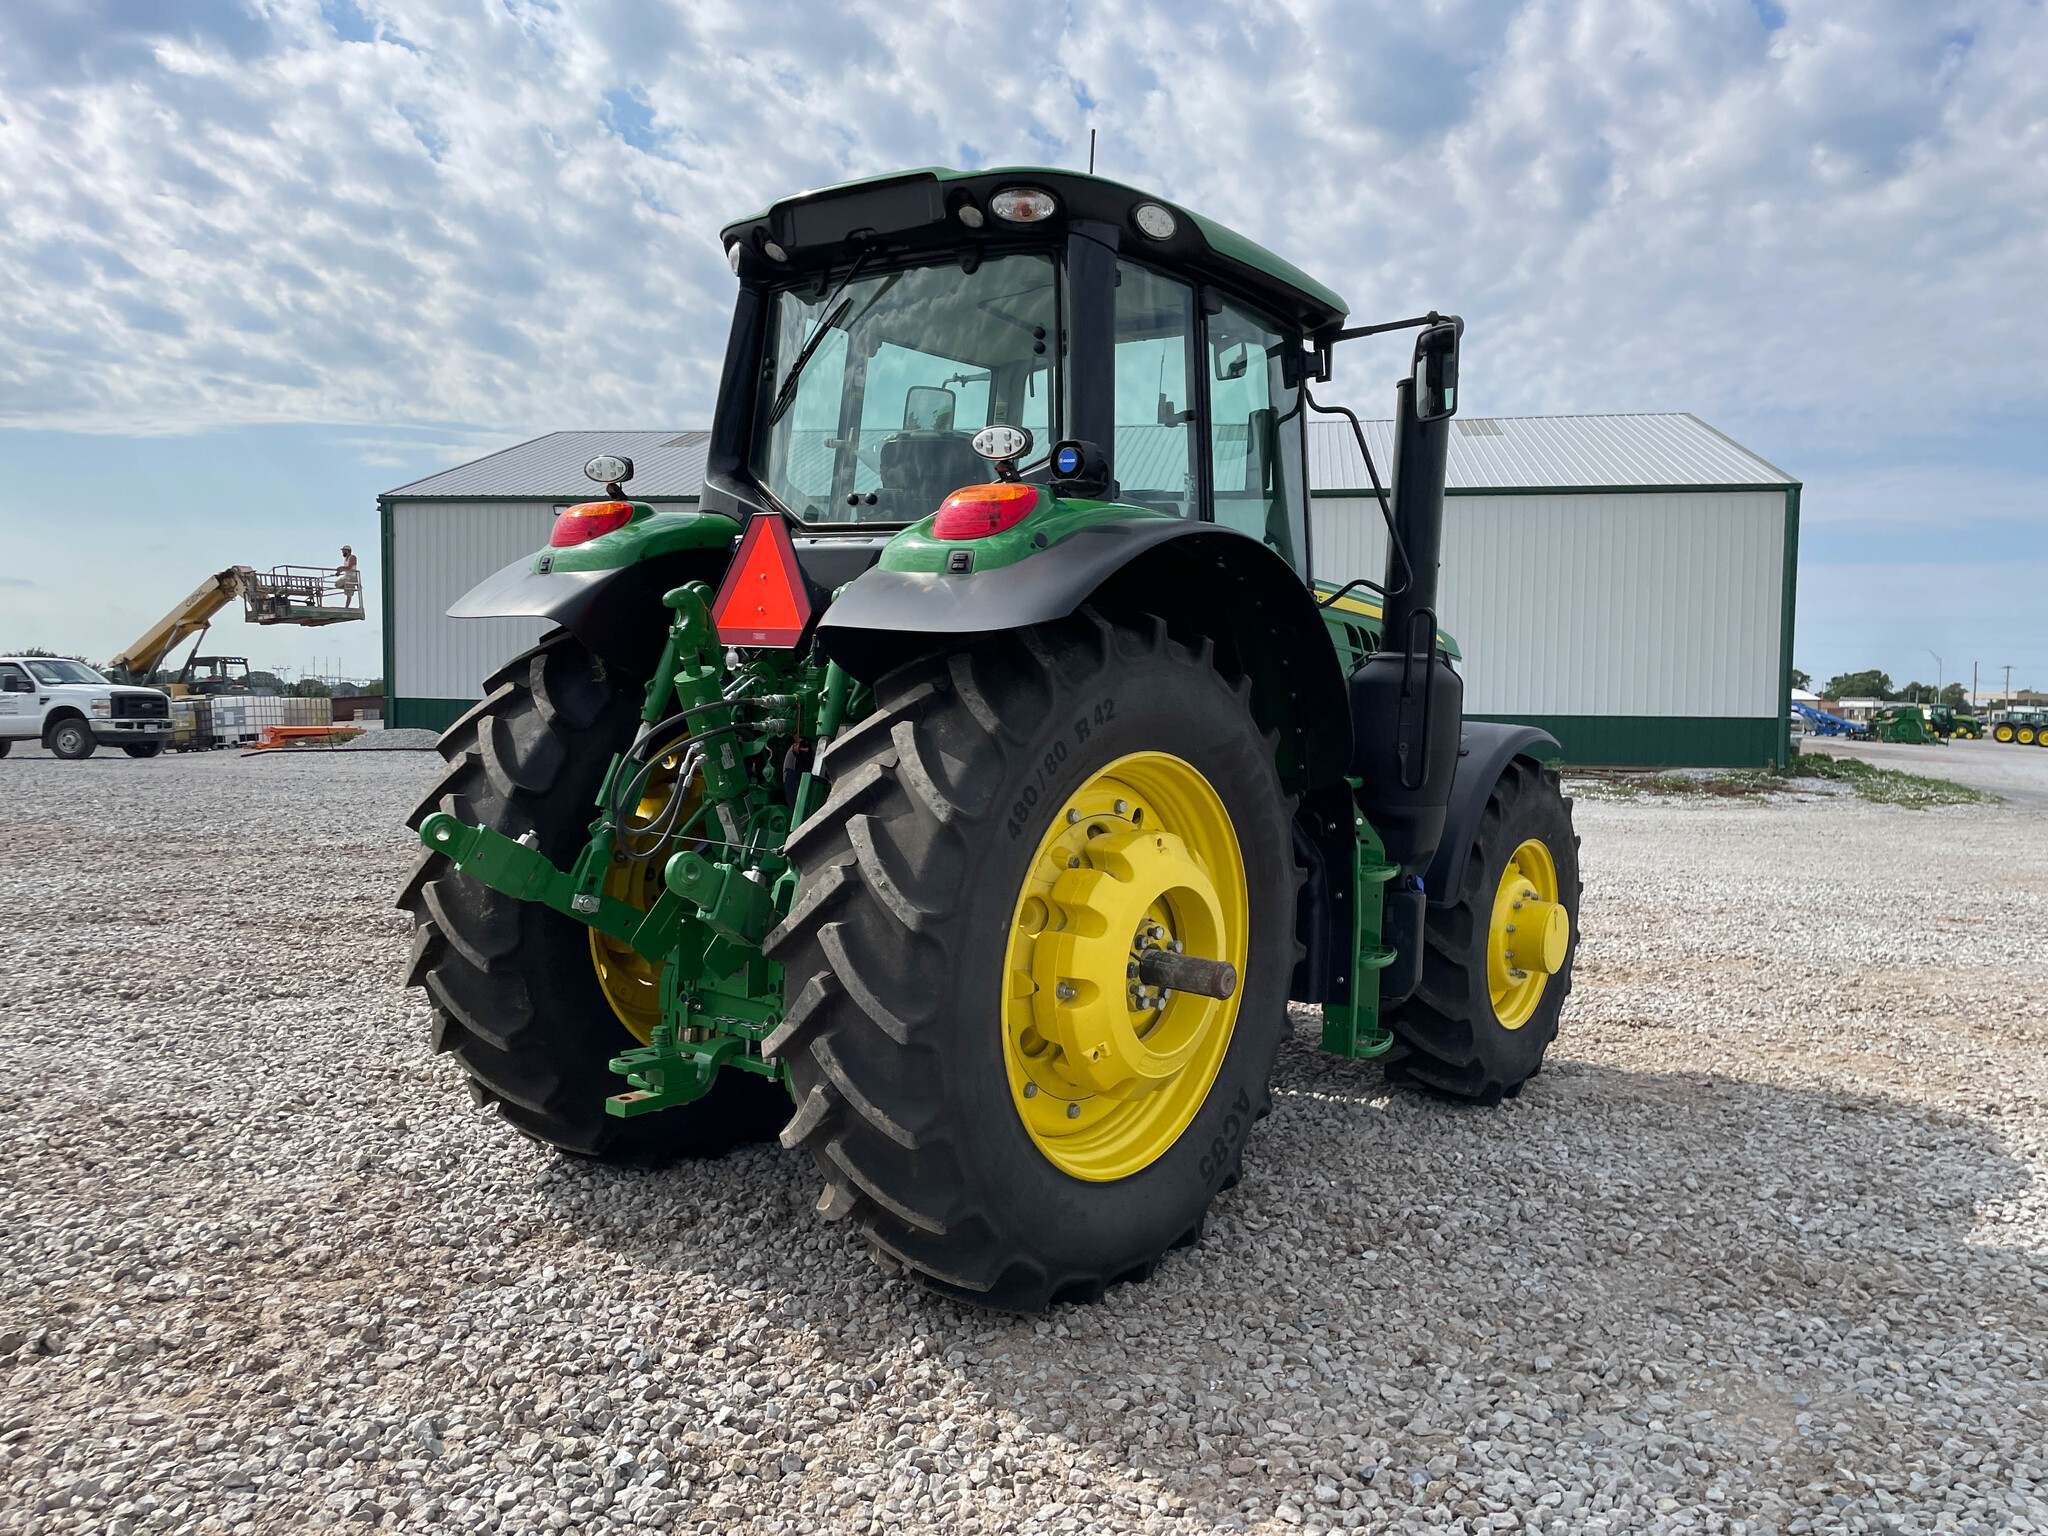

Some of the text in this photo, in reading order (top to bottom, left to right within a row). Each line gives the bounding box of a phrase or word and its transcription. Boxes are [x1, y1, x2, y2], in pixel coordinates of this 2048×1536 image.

[1007, 698, 1115, 840] 480/80 R 42
[1199, 1088, 1250, 1187] AC85
